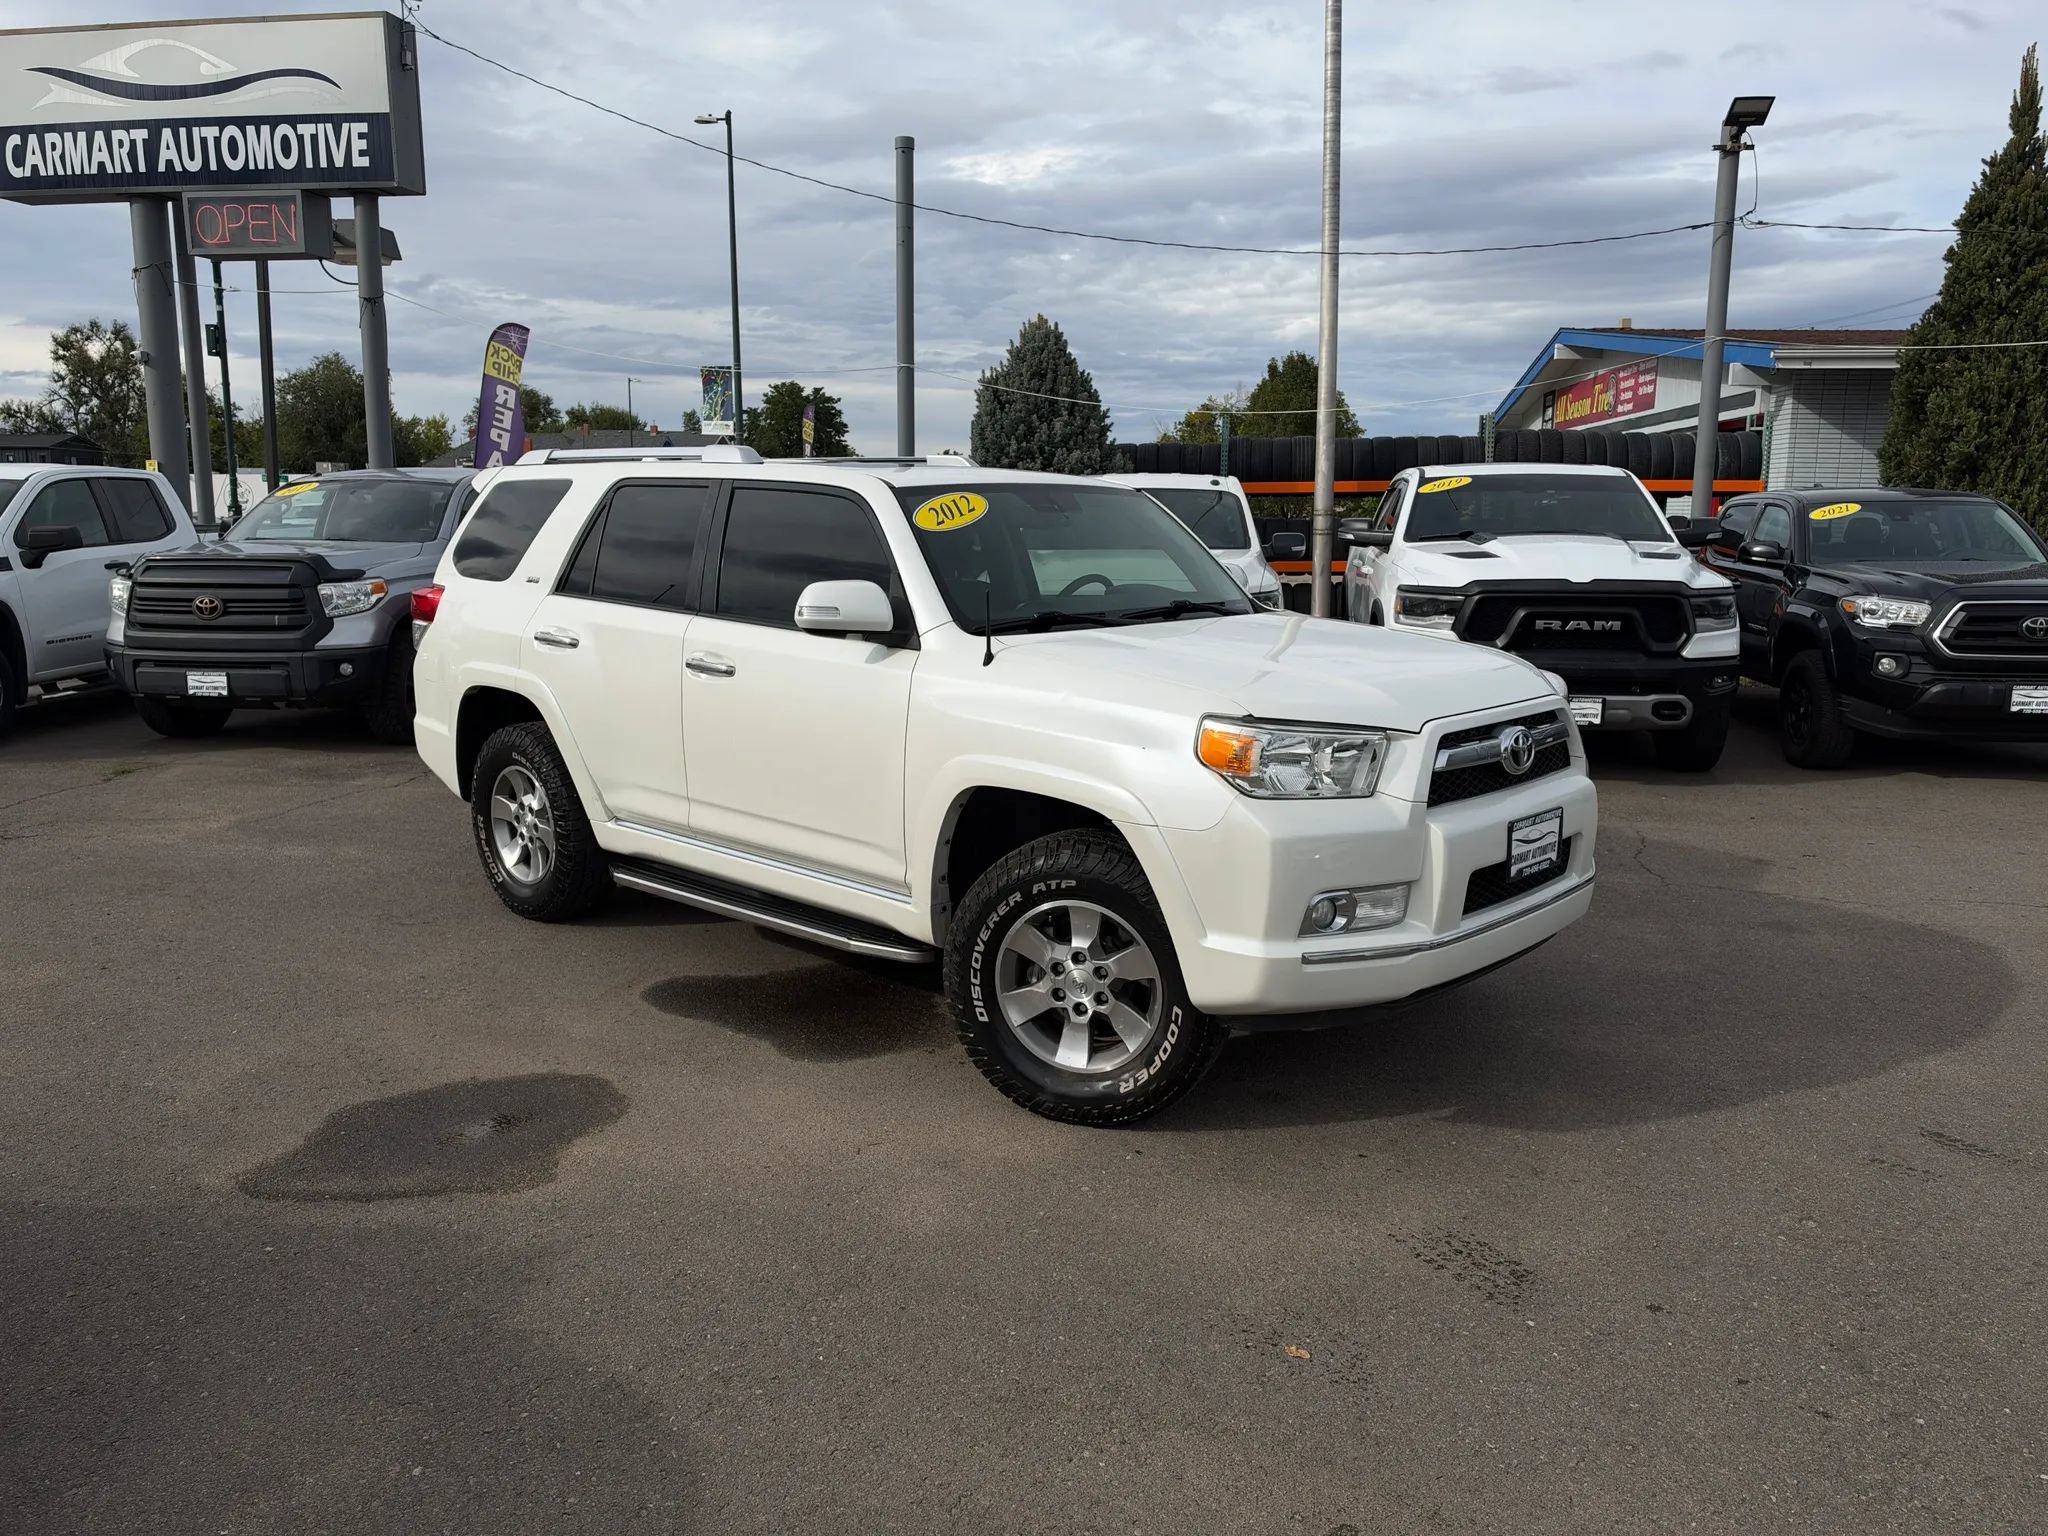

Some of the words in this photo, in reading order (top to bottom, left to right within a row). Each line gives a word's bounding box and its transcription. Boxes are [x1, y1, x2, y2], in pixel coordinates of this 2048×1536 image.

[5, 128, 149, 179] CARMART
[157, 122, 371, 173] AUTOMOTIVE
[195, 204, 297, 245] OPEN
[1556, 394, 1567, 423] All
[1566, 393, 1592, 420] Season
[1428, 478, 1463, 491] 2019
[927, 495, 976, 527] 2012
[1820, 504, 1850, 518] 2021
[1535, 619, 1622, 631] RAM
[1513, 816, 1536, 831] CARMART
[1535, 807, 1563, 825] AUTOMOTIVE
[1531, 840, 1557, 859] AUTOMOTIVE
[970, 890, 1023, 1023] DISCOVERER
[1032, 879, 1077, 895] ATP
[1119, 1005, 1183, 1094] COOPER
